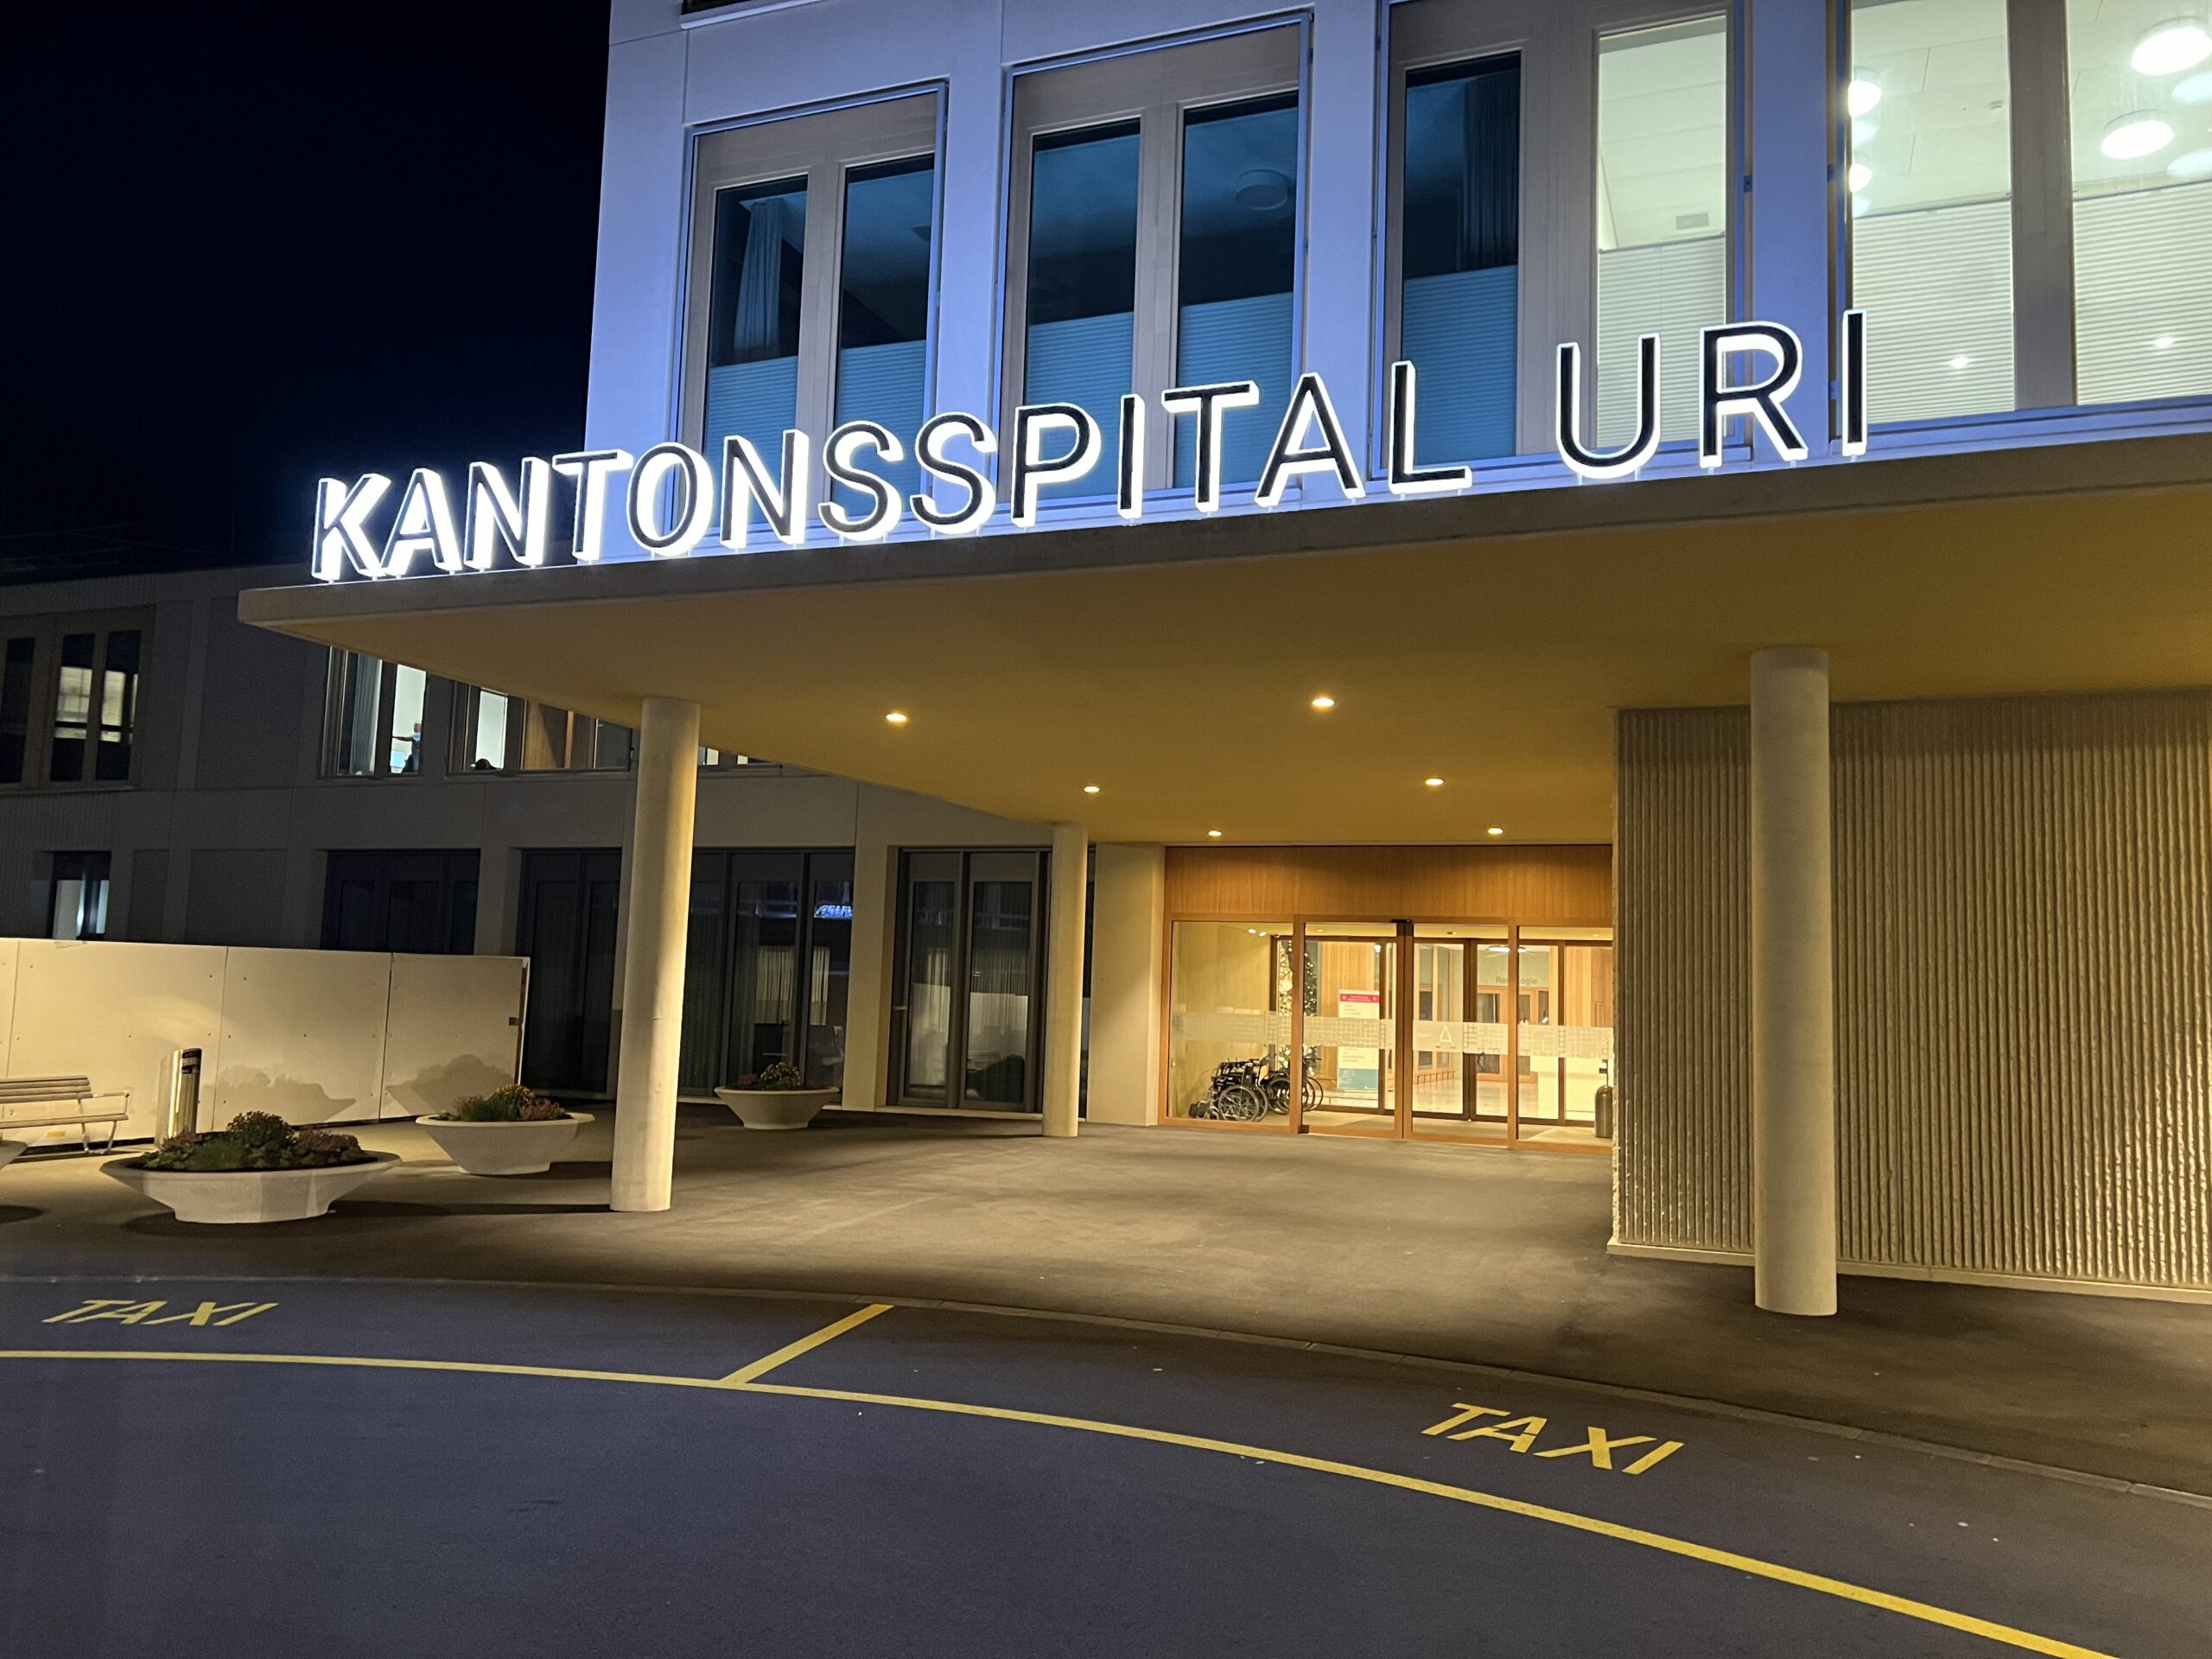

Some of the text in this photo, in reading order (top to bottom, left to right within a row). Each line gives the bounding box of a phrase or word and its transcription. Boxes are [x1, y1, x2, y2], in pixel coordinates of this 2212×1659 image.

[311, 308, 1868, 582] KANTONSSPITAL URI
[1495, 976, 1539, 985] Raogie
[41, 1300, 279, 1325] TAXI
[1421, 1402, 1685, 1475] TAXI
